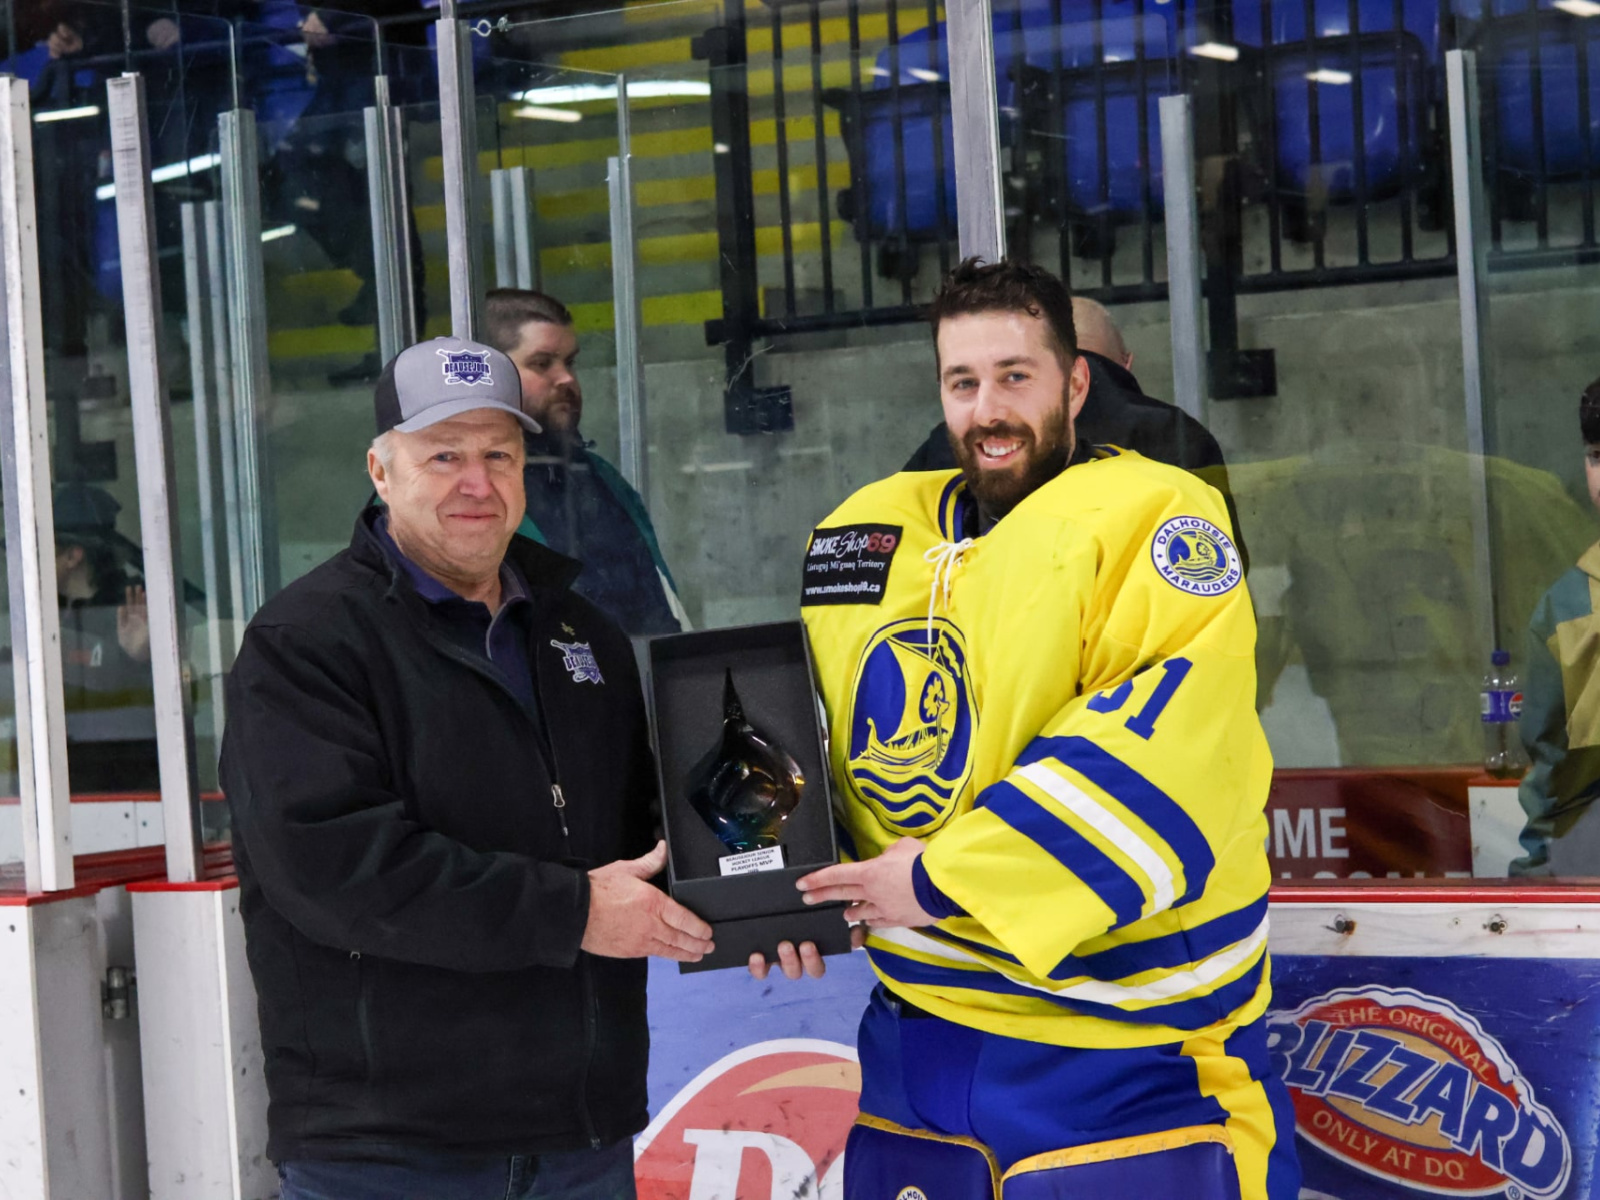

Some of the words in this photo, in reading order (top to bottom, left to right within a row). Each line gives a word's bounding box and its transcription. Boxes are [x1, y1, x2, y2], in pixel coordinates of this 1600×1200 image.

[810, 535, 841, 556] SMOKE
[1157, 519, 1231, 549] DALHOUSIE
[857, 559, 886, 571] Territory
[1161, 565, 1239, 592] MARAUDERS
[731, 863, 759, 872] PLAYOFFS
[1336, 1006, 1382, 1025] THE
[1388, 1009, 1490, 1081] ORIGINAL
[1312, 1109, 1379, 1157] ONLY
[1382, 1147, 1416, 1171] AT
[1425, 1156, 1466, 1181] DQ
